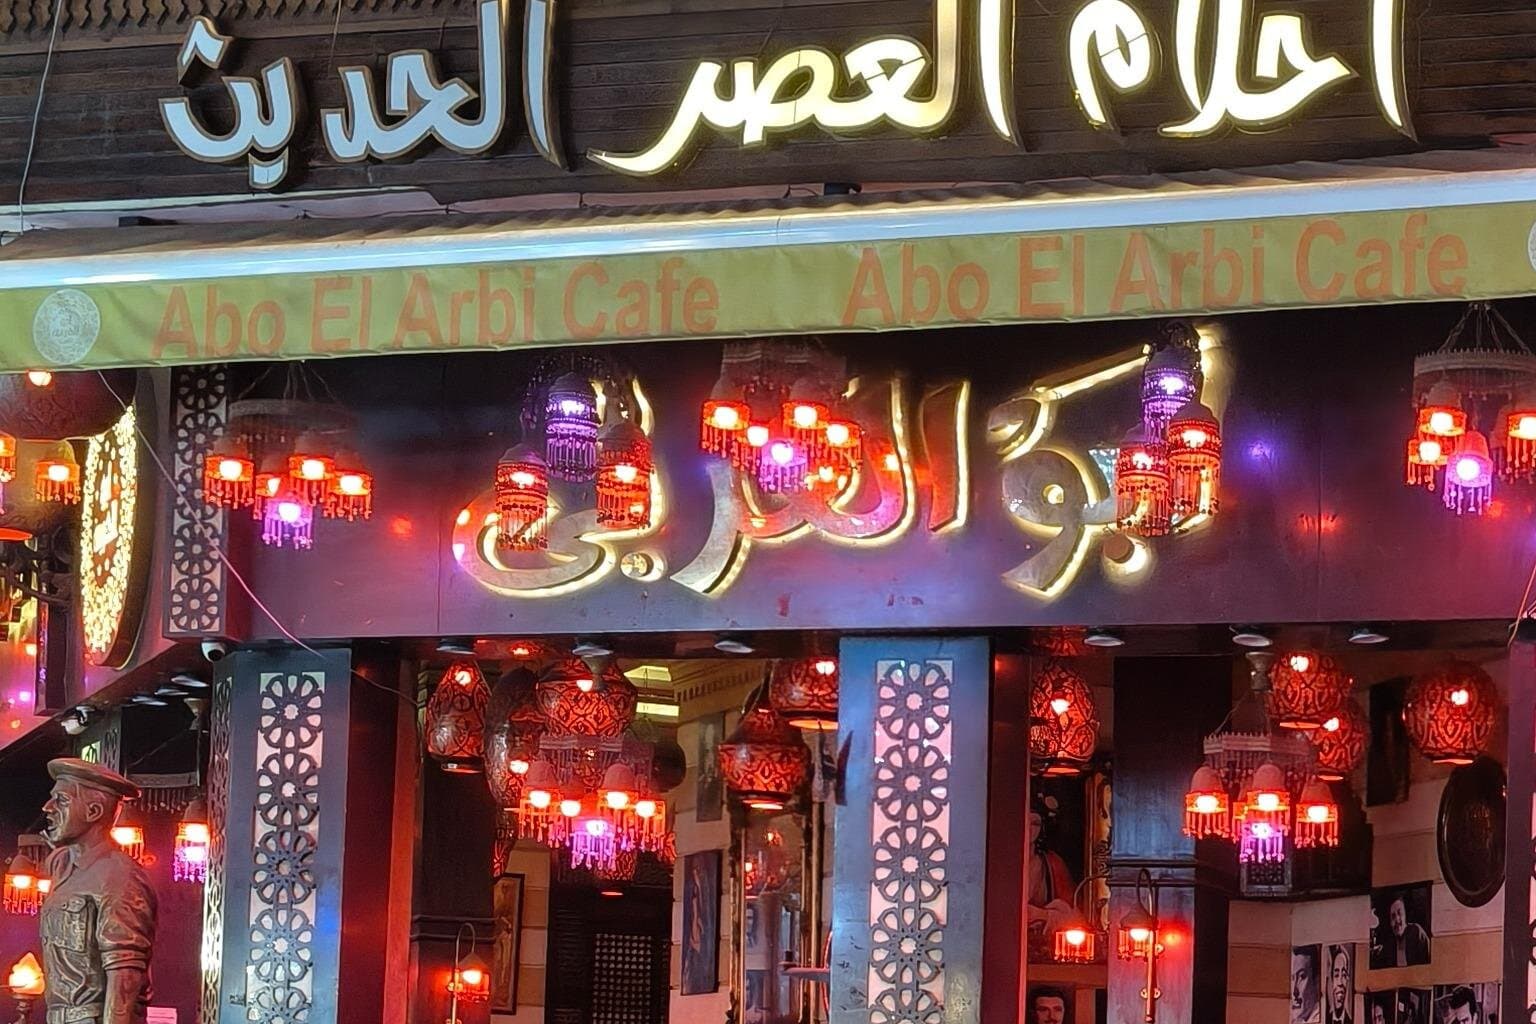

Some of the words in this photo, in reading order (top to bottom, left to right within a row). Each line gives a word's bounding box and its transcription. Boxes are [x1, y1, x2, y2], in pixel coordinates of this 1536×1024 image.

[150, 285, 286, 359] Abo
[311, 275, 372, 352] El
[399, 264, 535, 348] Arbi
[564, 257, 719, 338] Cafe
[843, 247, 990, 326] Abo
[1018, 234, 1086, 319] El
[1110, 224, 1266, 314] Arbi
[1295, 213, 1469, 302] Cafe
